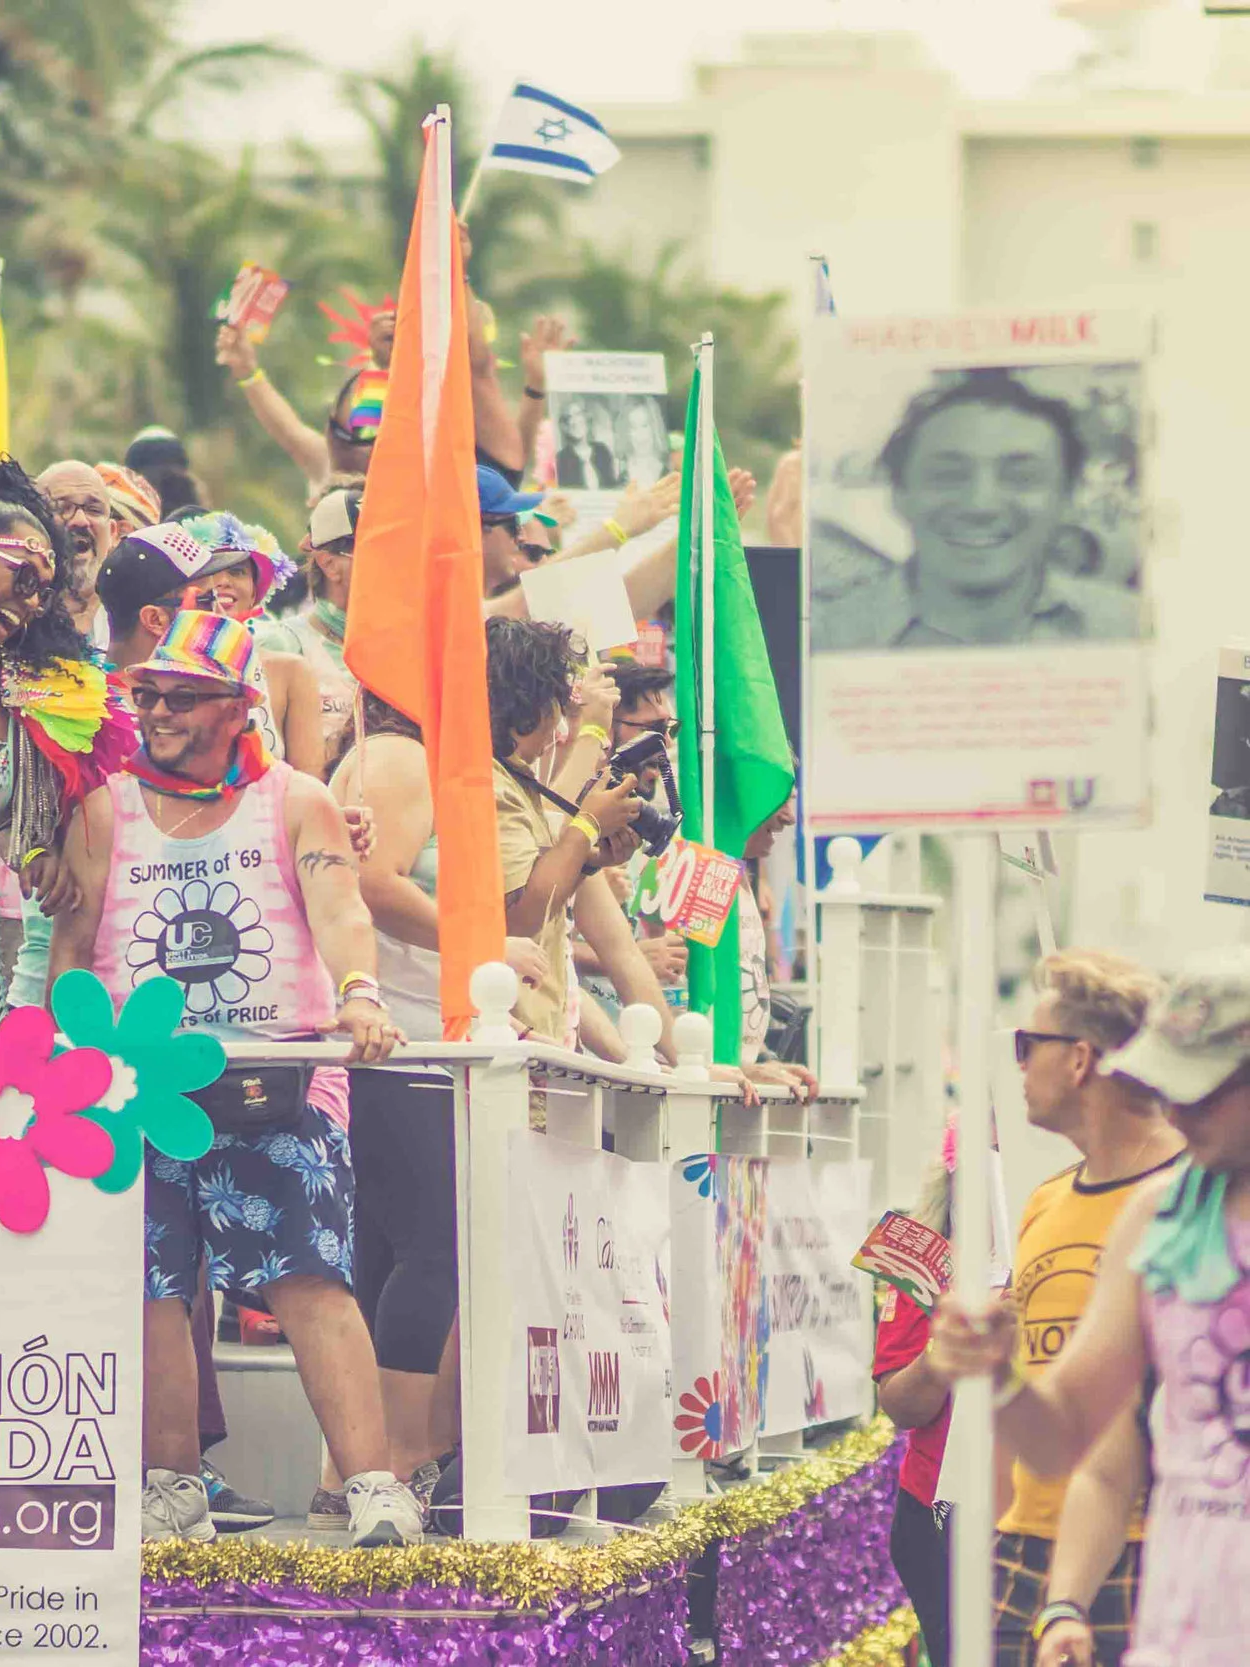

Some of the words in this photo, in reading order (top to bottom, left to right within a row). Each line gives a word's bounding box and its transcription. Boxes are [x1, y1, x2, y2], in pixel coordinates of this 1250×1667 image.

[129, 860, 209, 884] SUMMER
[213, 853, 230, 874] of
[166, 921, 213, 951] UC
[204, 1009, 221, 1024] of
[227, 1005, 279, 1024] PRIDE
[885, 1217, 911, 1242] AIDS
[75, 1587, 98, 1610] in
[33, 1624, 108, 1649] 2002.
